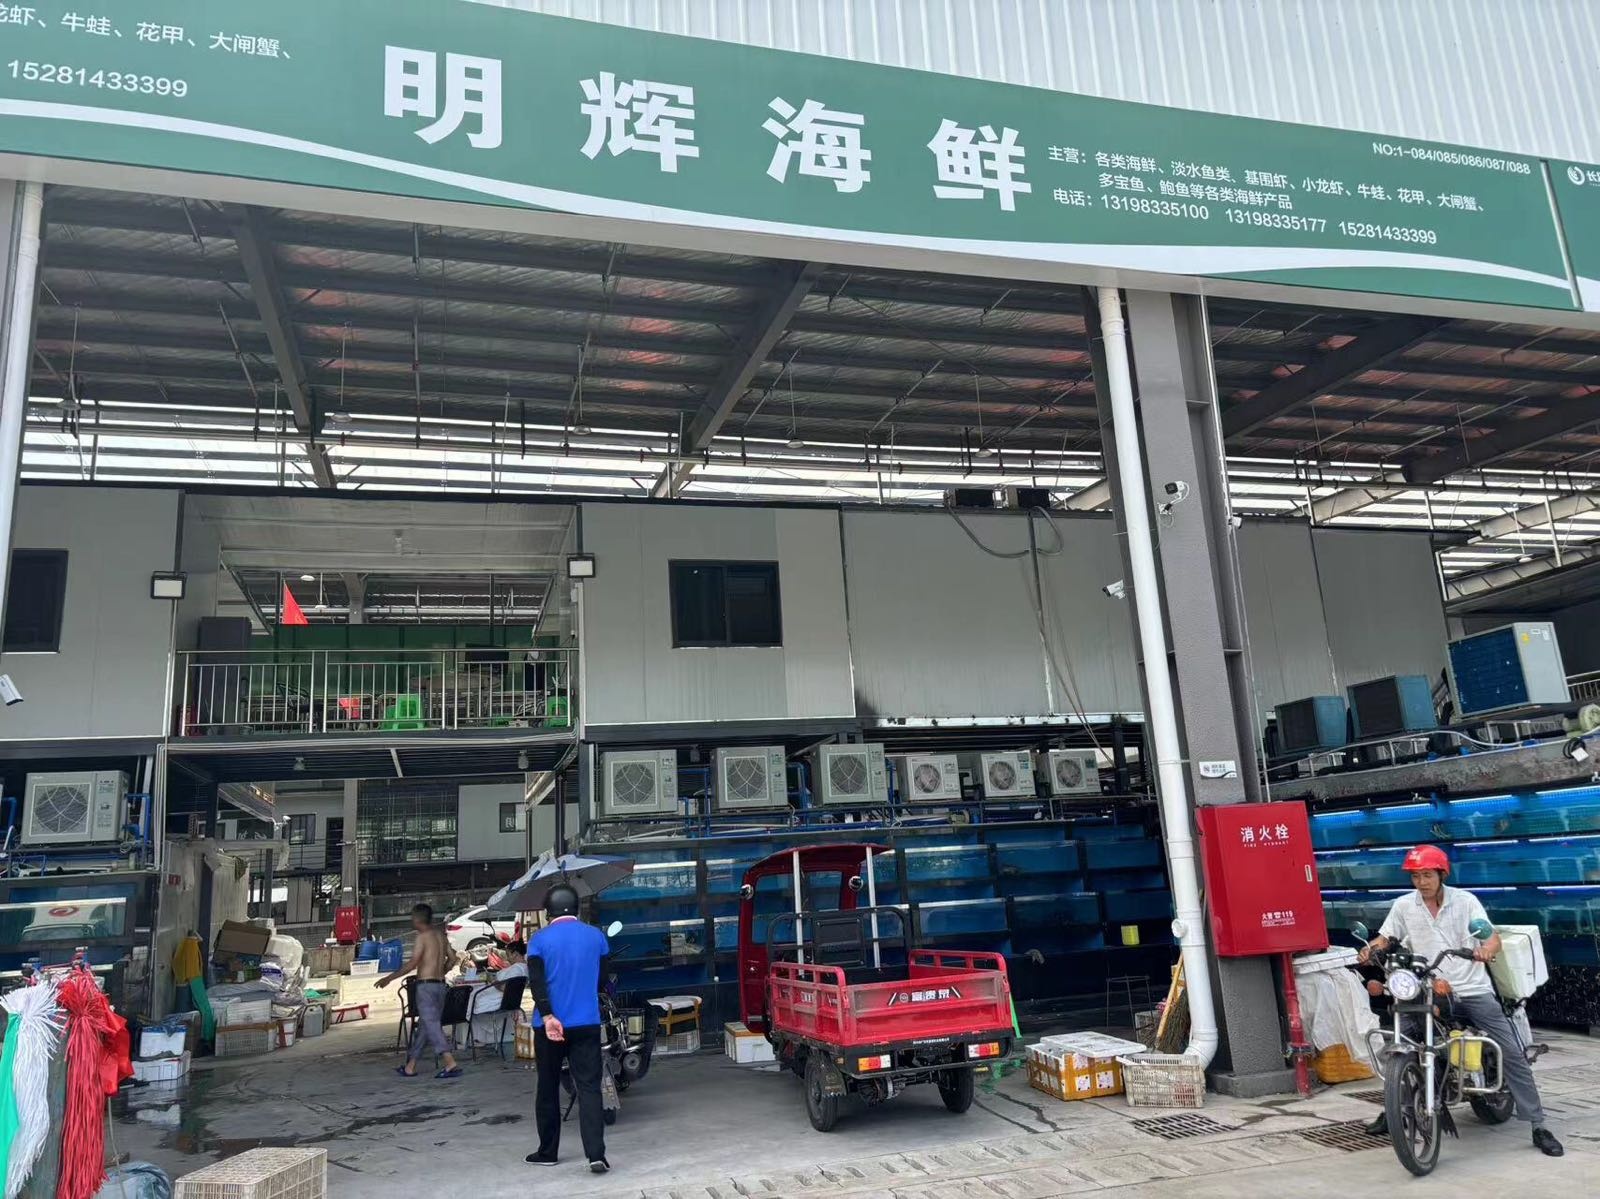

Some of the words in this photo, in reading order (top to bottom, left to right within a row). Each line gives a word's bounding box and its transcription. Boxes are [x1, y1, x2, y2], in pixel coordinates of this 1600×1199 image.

[8, 59, 188, 98] 15281433399
[384, 45, 1032, 212] 明辉海鲜
[1225, 208, 1327, 233] 13198335177
[1338, 221, 1438, 245] 15281433399
[1240, 823, 1290, 843] 消火栓
